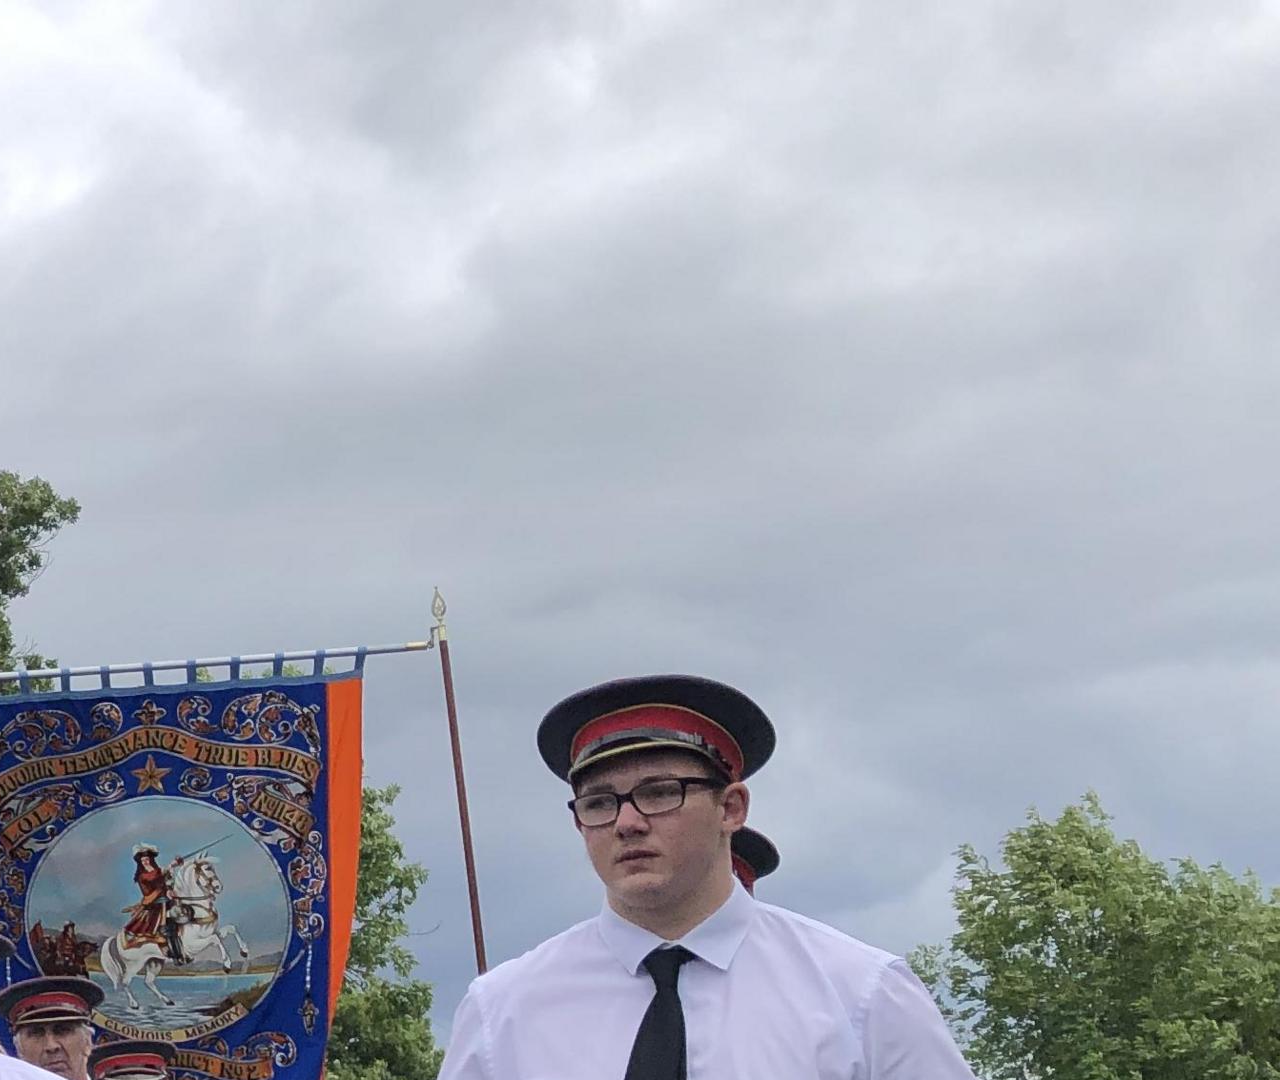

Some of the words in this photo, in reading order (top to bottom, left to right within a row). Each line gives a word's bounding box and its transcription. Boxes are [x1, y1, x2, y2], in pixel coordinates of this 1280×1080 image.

[59, 728, 186, 776] TEMPERANCE
[194, 741, 249, 766] TRUE
[255, 748, 317, 781] BLUES
[104, 1019, 173, 1040] GLORIOUS
[184, 1006, 242, 1039] MEMORY
